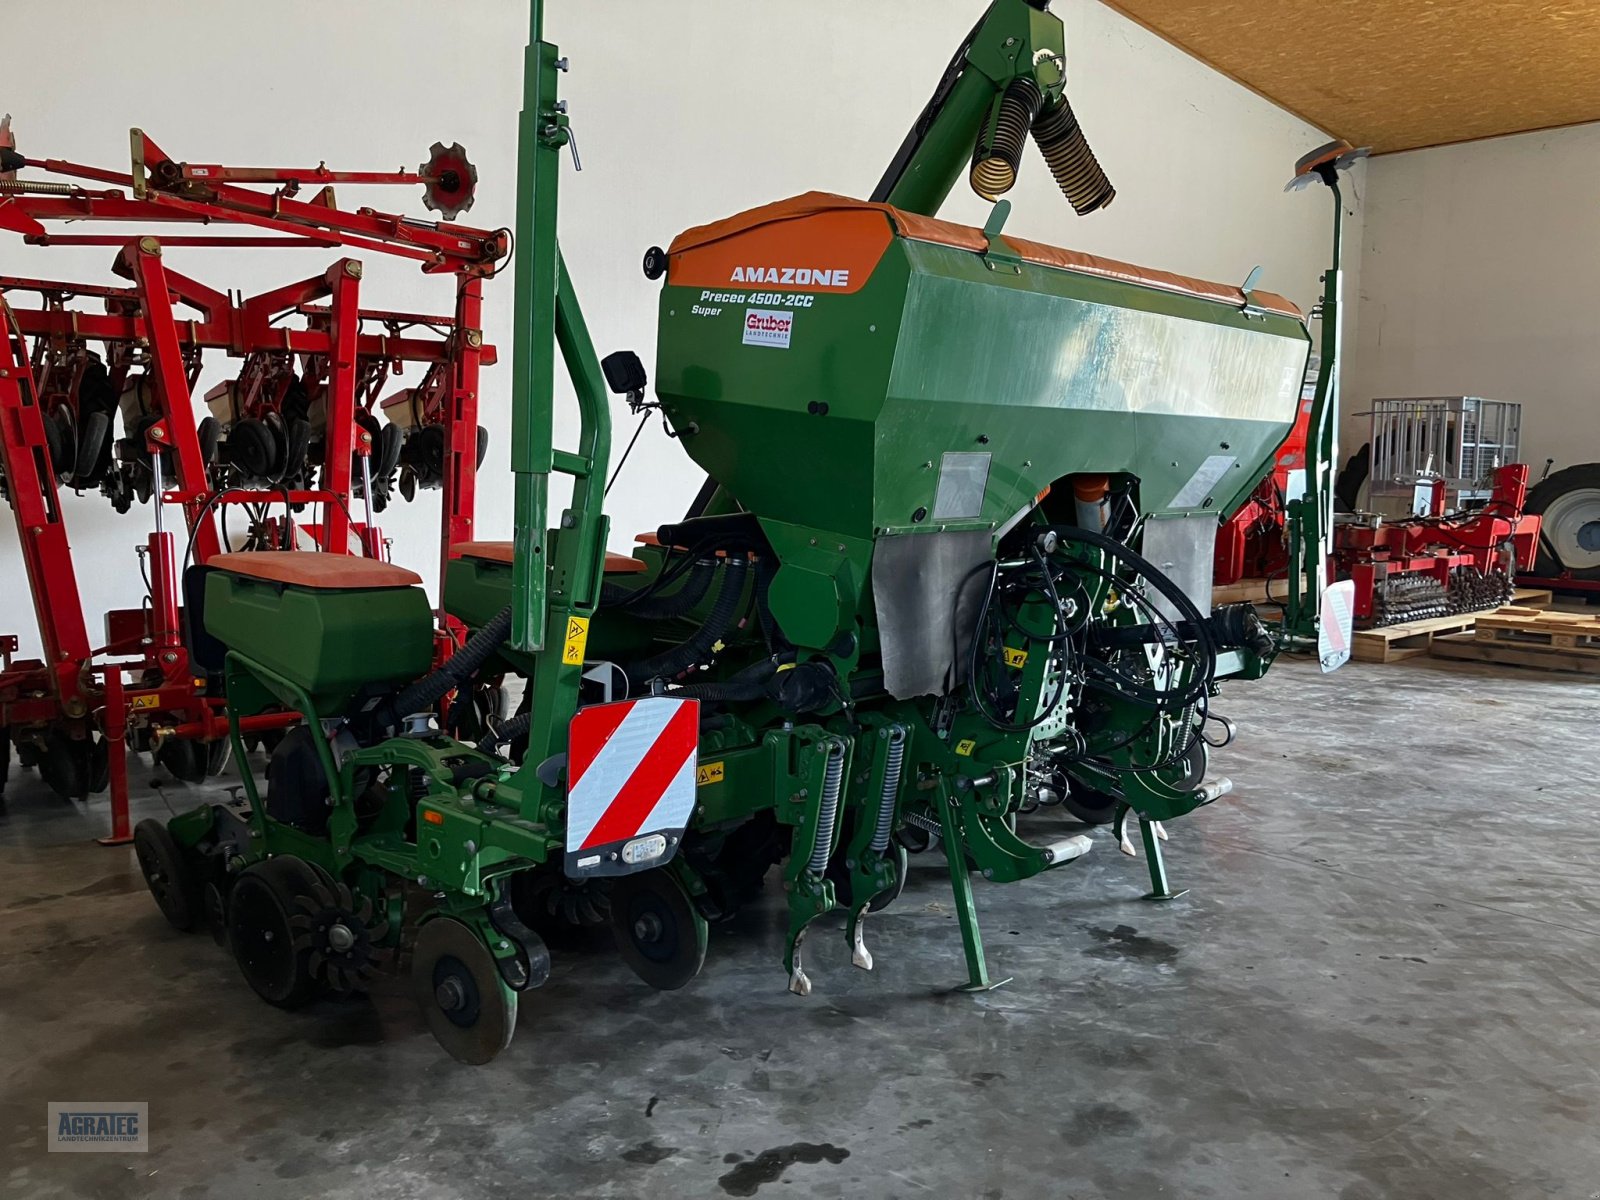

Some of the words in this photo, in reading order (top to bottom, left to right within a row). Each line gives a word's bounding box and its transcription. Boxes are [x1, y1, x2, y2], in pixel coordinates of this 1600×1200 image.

[730, 266, 849, 287] AMAZONE
[700, 290, 746, 304] Precea
[747, 292, 814, 308] 4500-2CC
[691, 305, 722, 317] Super
[747, 313, 791, 332] Gruber
[745, 330, 789, 340] LANDTECHNIK
